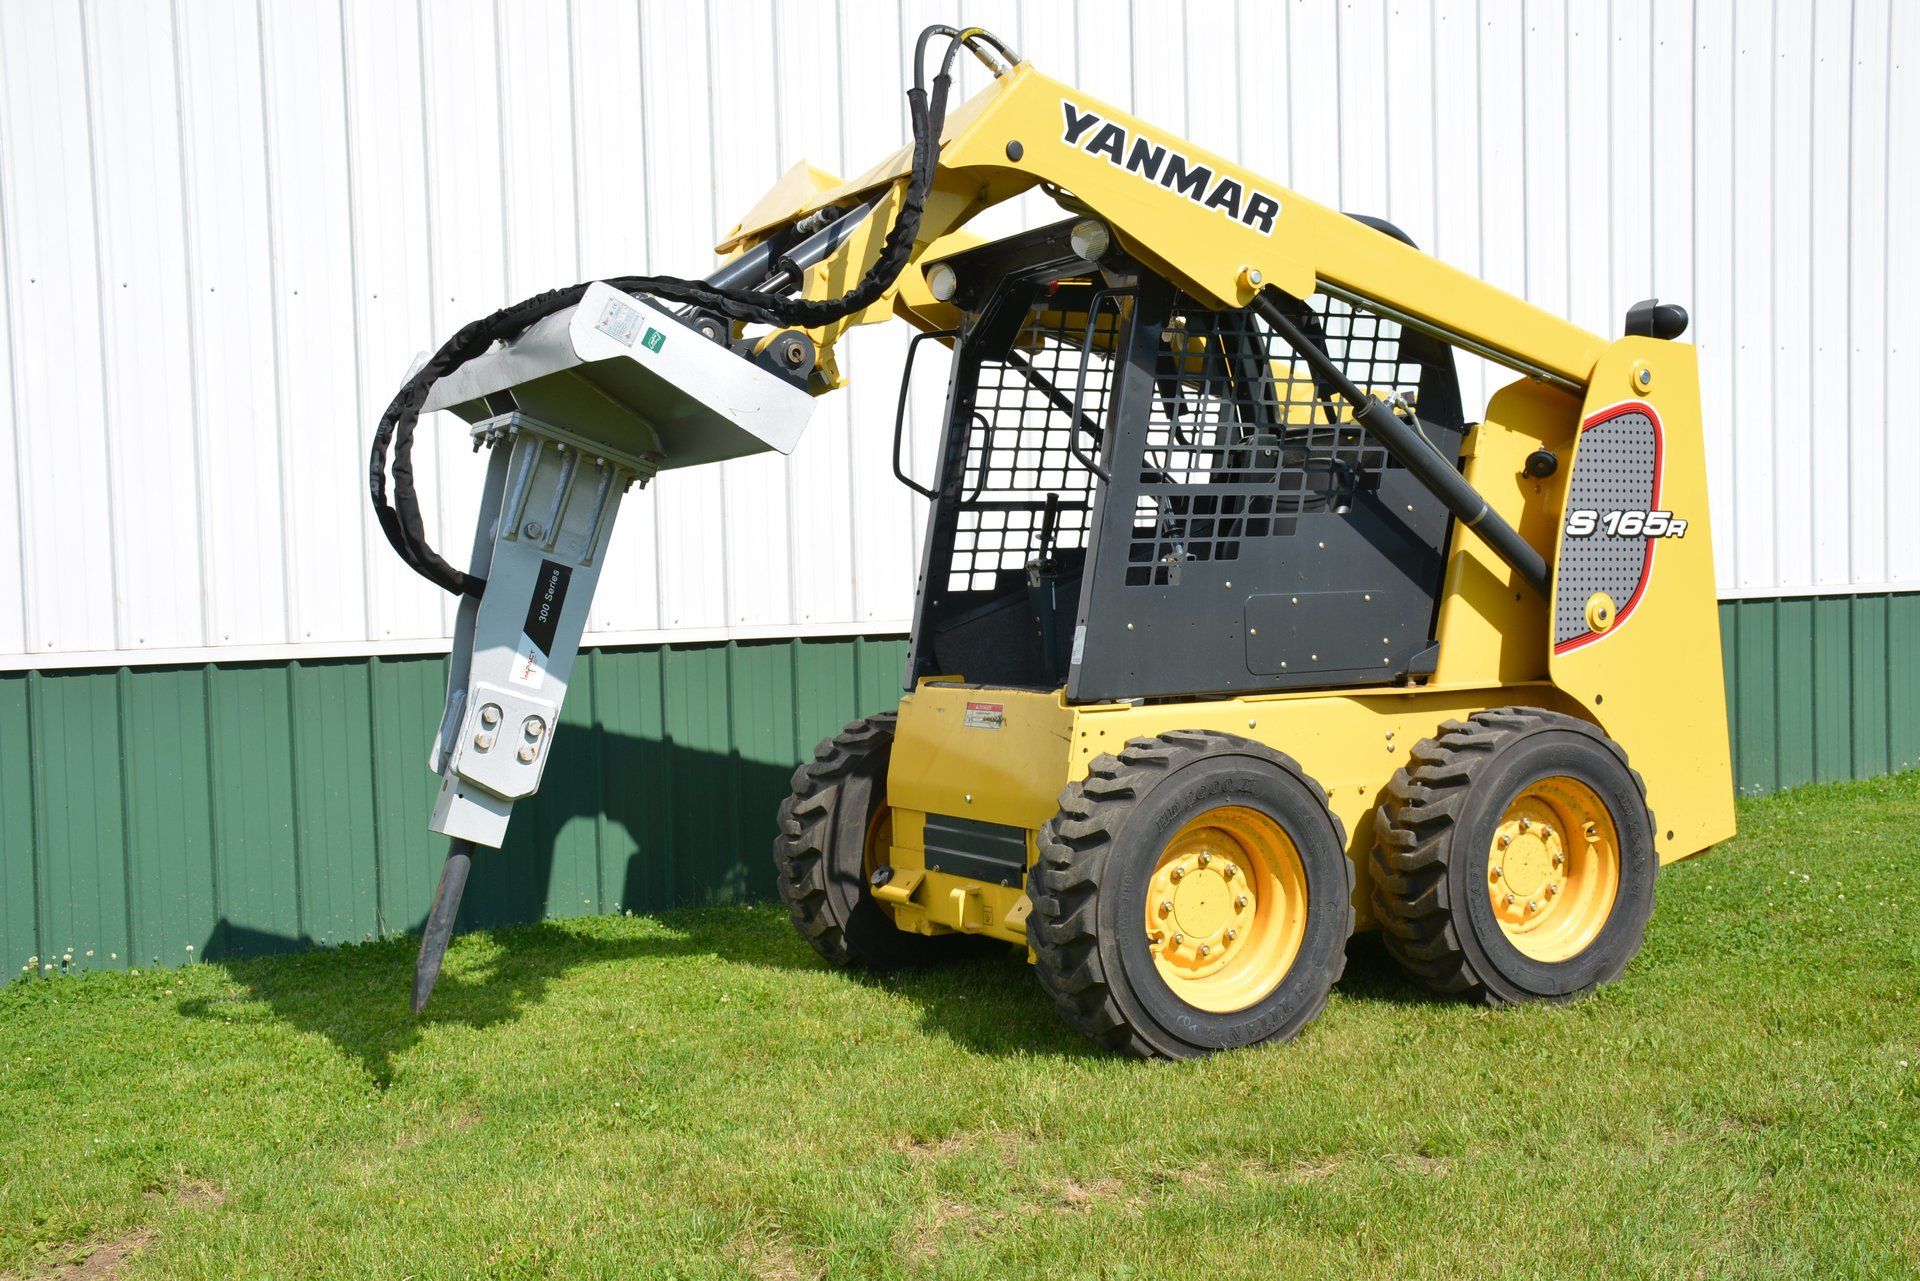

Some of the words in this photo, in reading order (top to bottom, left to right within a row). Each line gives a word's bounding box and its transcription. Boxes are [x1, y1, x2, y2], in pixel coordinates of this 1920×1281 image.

[1062, 100, 1281, 236] YANMAR
[1565, 509, 1600, 538] S
[1602, 509, 1689, 538] 165R
[544, 569, 560, 602] Series
[538, 603, 551, 624] 300
